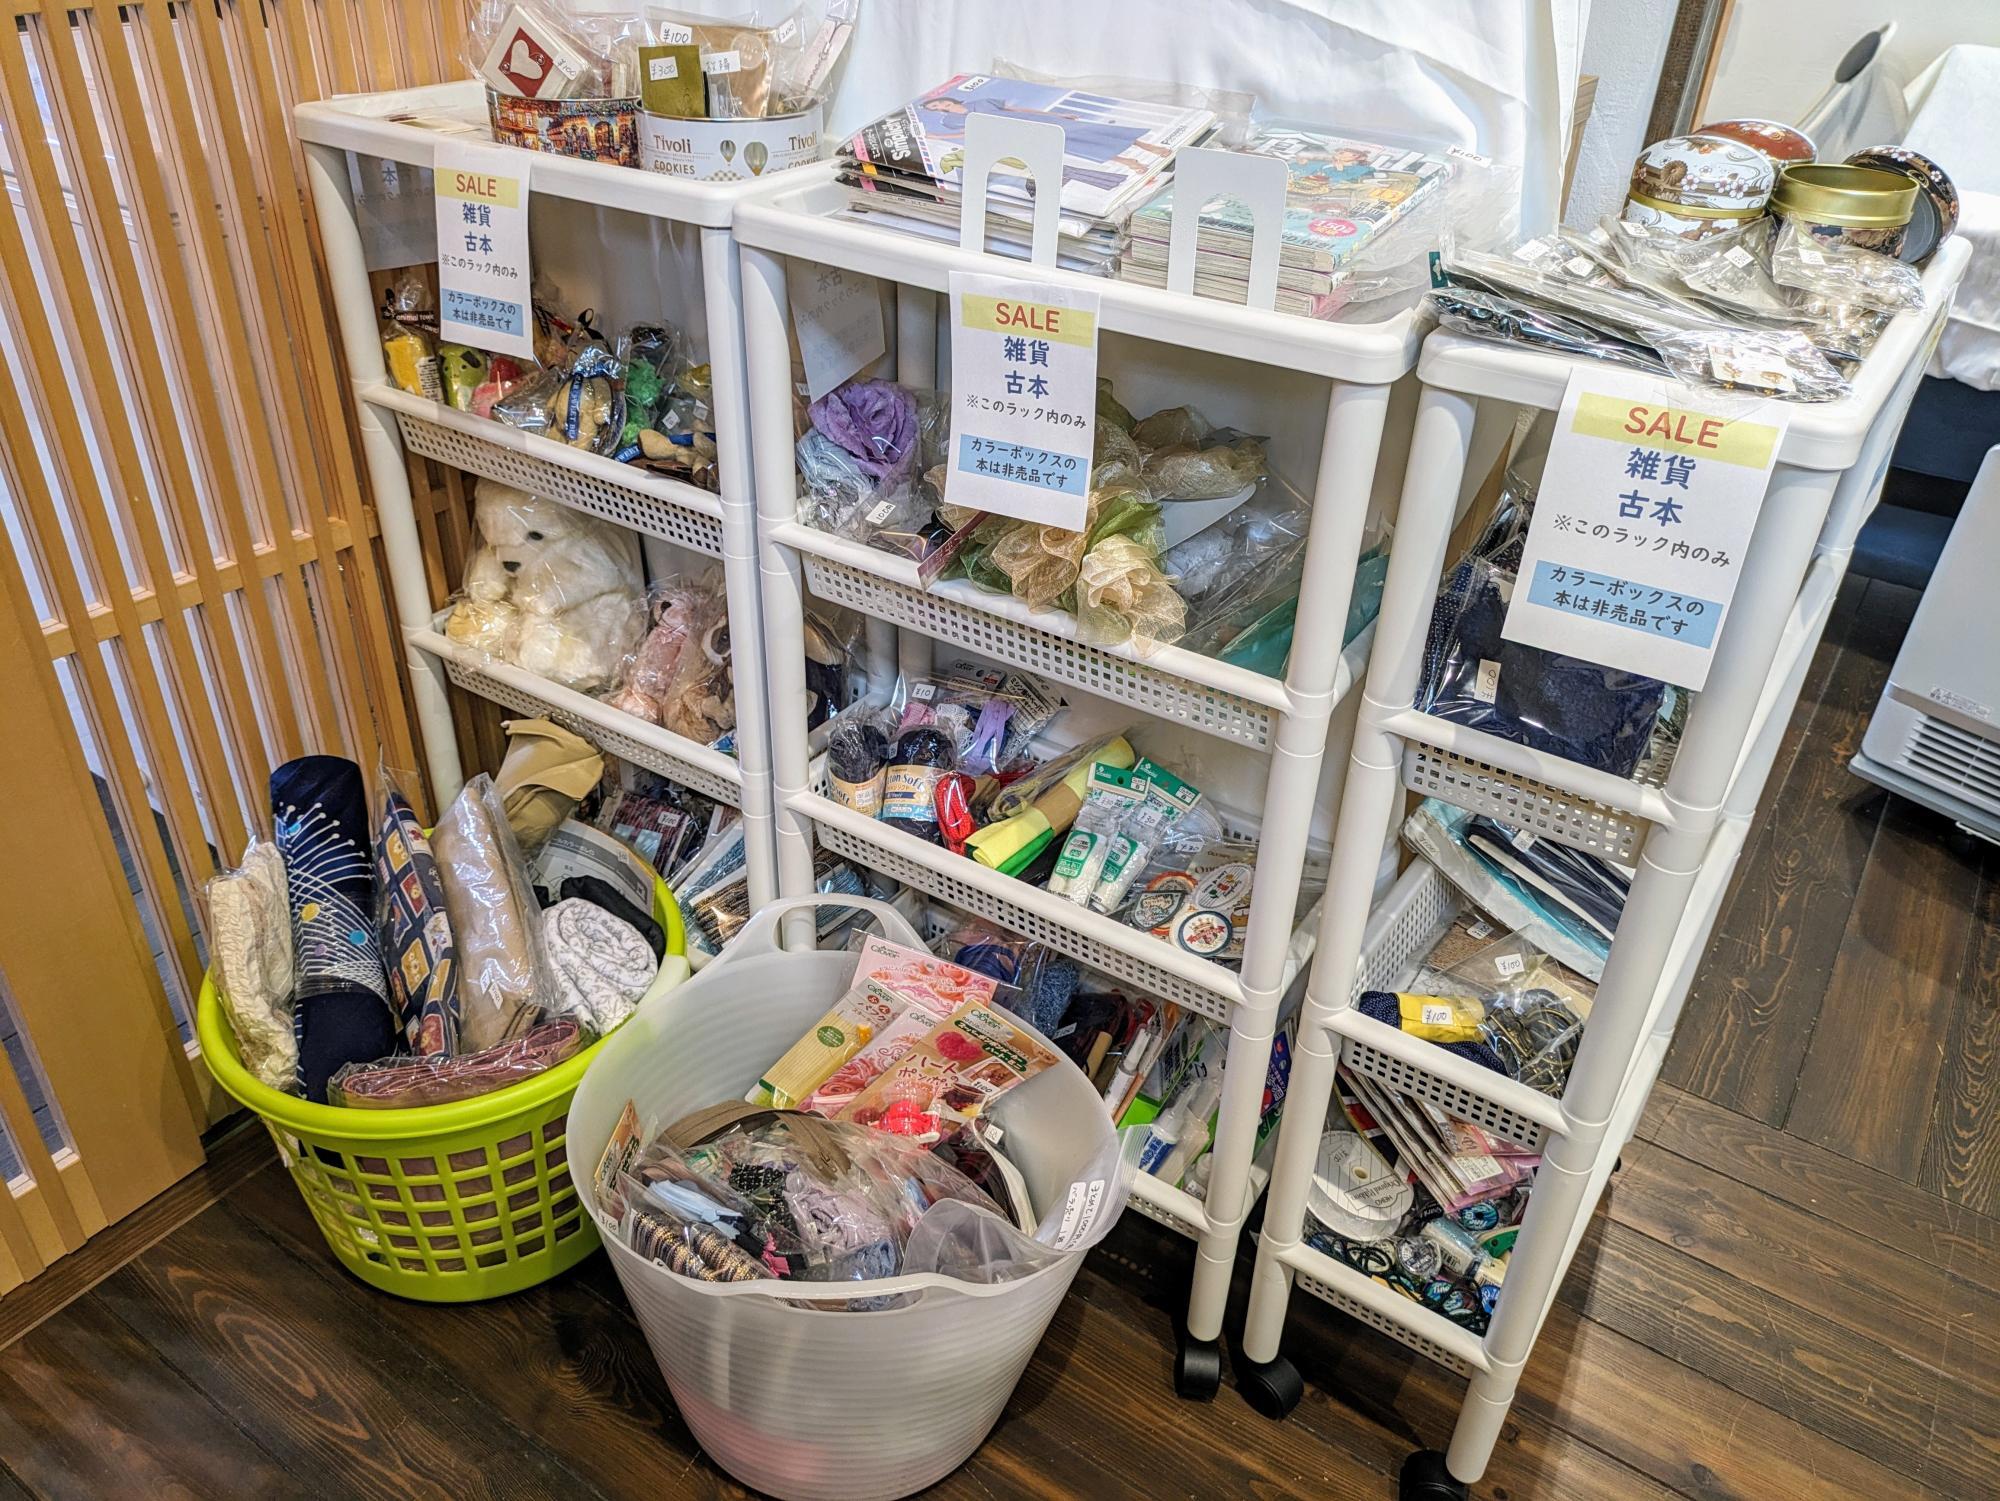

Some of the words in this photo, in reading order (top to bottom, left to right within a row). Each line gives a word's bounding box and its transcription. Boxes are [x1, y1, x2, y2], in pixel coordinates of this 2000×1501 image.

[663, 29, 689, 43] ¥100
[557, 59, 577, 76] ¥100
[651, 64, 676, 81] ¥300
[654, 135, 692, 153] Tivoli
[789, 132, 818, 150] Tivoli
[654, 159, 696, 174] COOKIES
[1450, 147, 1483, 162] ¥100
[456, 174, 497, 198] SALE
[462, 201, 491, 229] 雑貨
[464, 231, 493, 255] 古本
[441, 253, 518, 279] ※このラック内のみ
[447, 291, 516, 315] カラーボックスの
[452, 307, 512, 331] 本は非売品です
[995, 302, 1061, 333] SALE
[1004, 336, 1050, 368] 雑貨
[1004, 370, 1049, 400] 古本
[966, 393, 1087, 429] ※このラック内のみ
[1624, 406, 1725, 449] SALE
[972, 437, 1077, 471] カラーボックスの
[975, 457, 1068, 489] 本は非売品です
[1624, 447, 1697, 490] 雑貨
[1618, 490, 1684, 527] 古本
[1553, 513, 1730, 568] ※このラック内のみ
[1549, 566, 1704, 617] カラーボックスの
[1552, 590, 1689, 636] 本は非売品です
[916, 686, 931, 697] ¥10
[1481, 669, 1496, 700] ¥100
[903, 773, 925, 793] Soft
[870, 944, 900, 958] Clover
[1500, 959, 1521, 971] ¥100
[867, 984, 893, 1004] Clover
[909, 1011, 936, 1029] Clover
[970, 1008, 1001, 1030] Clover
[1425, 1008, 1448, 1023] ¥100
